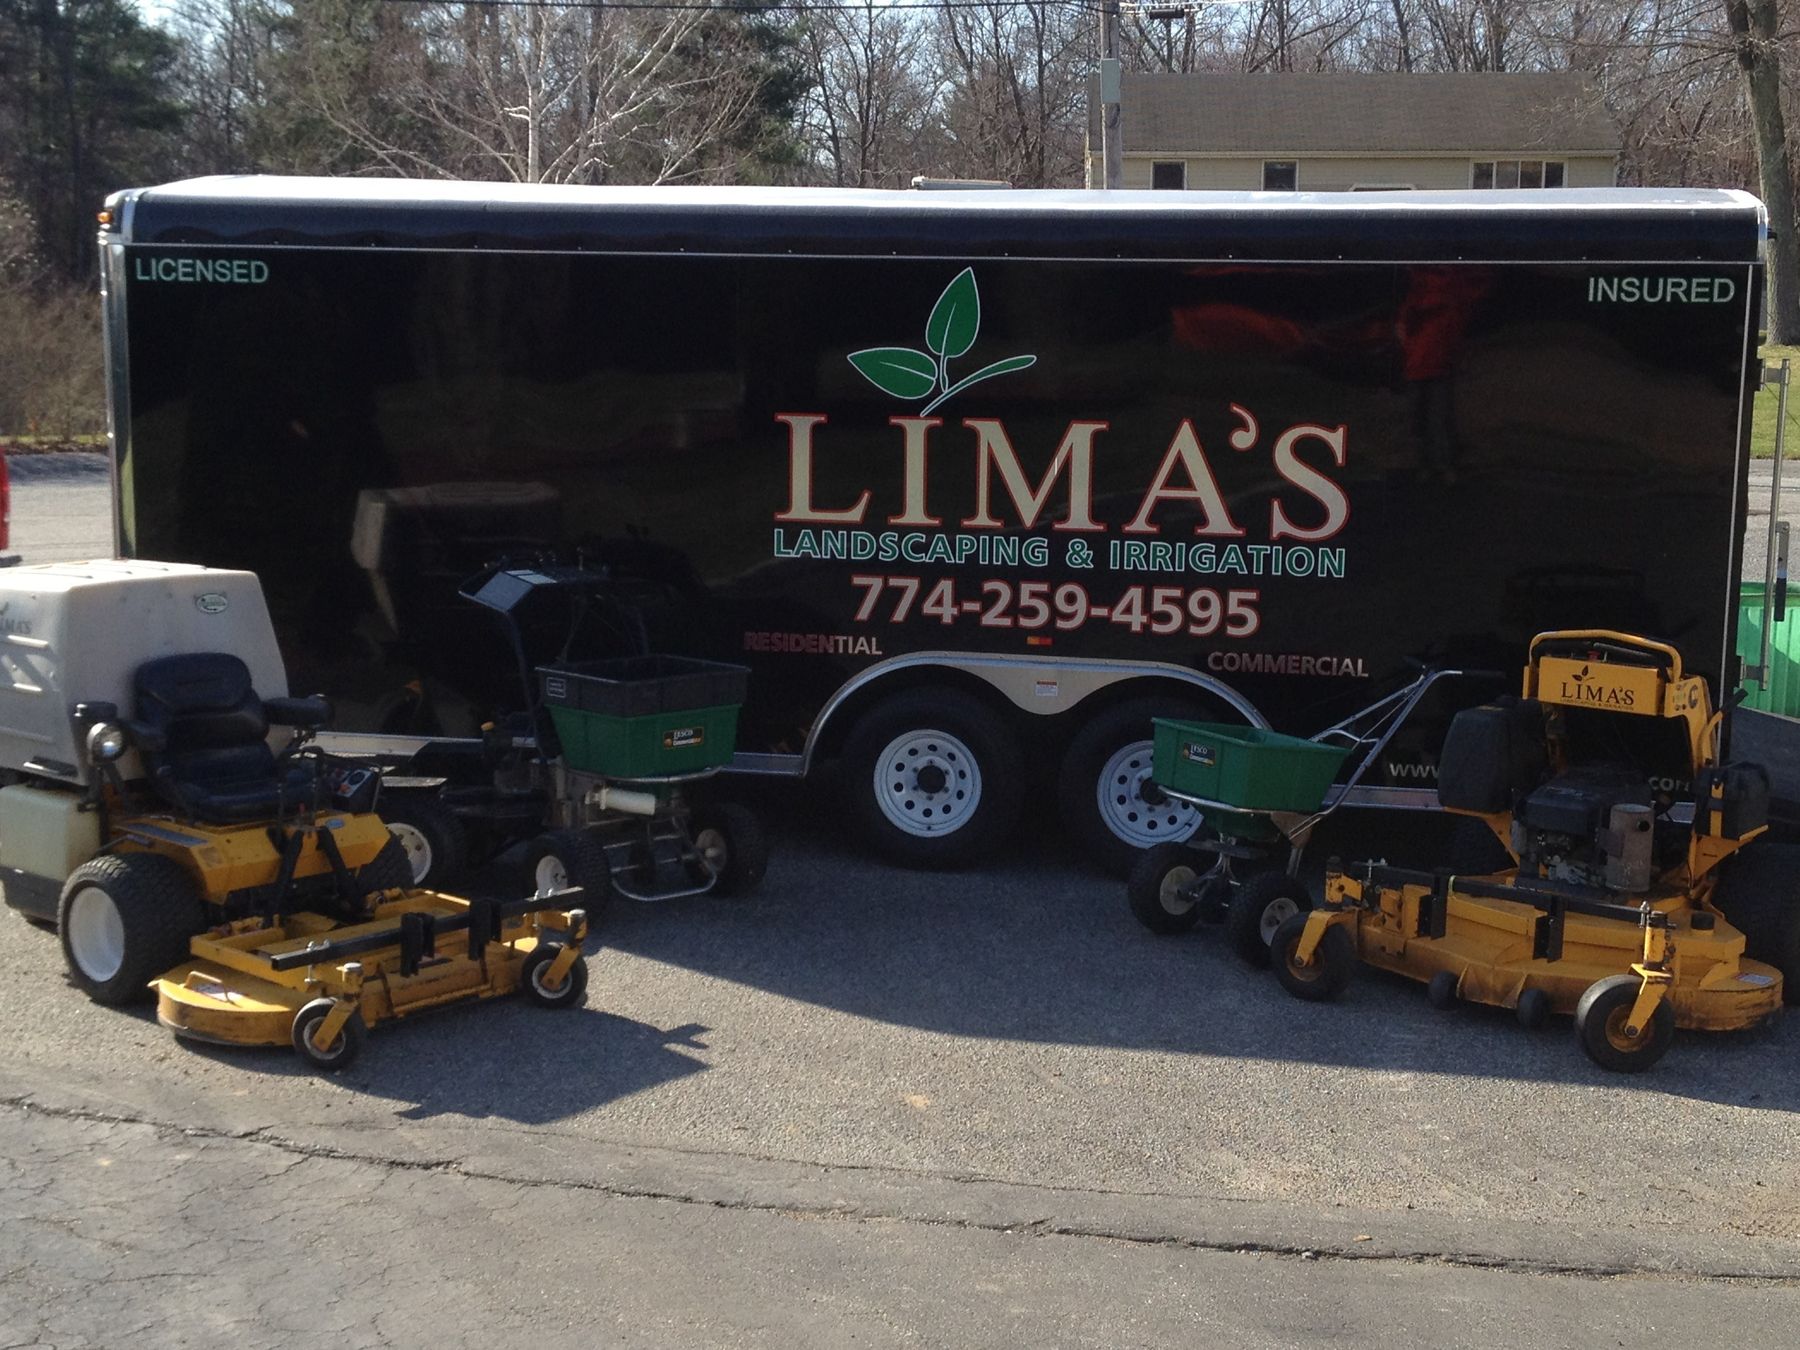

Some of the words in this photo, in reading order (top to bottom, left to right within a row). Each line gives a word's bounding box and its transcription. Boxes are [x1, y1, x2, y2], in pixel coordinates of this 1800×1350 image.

[135, 257, 269, 284] LICENSED
[1588, 276, 1736, 303] INSURED
[773, 402, 1351, 541] LIMA'S
[773, 528, 1049, 568] LANDSCAPING
[1065, 538, 1095, 570] &
[1109, 538, 1346, 579] IRRIGATION
[850, 574, 1262, 638] 774-259-4595
[744, 632, 883, 656] RESIDENTIAL
[1206, 650, 1370, 678] COMMERCIAL
[1561, 681, 1635, 706] LIMA'S
